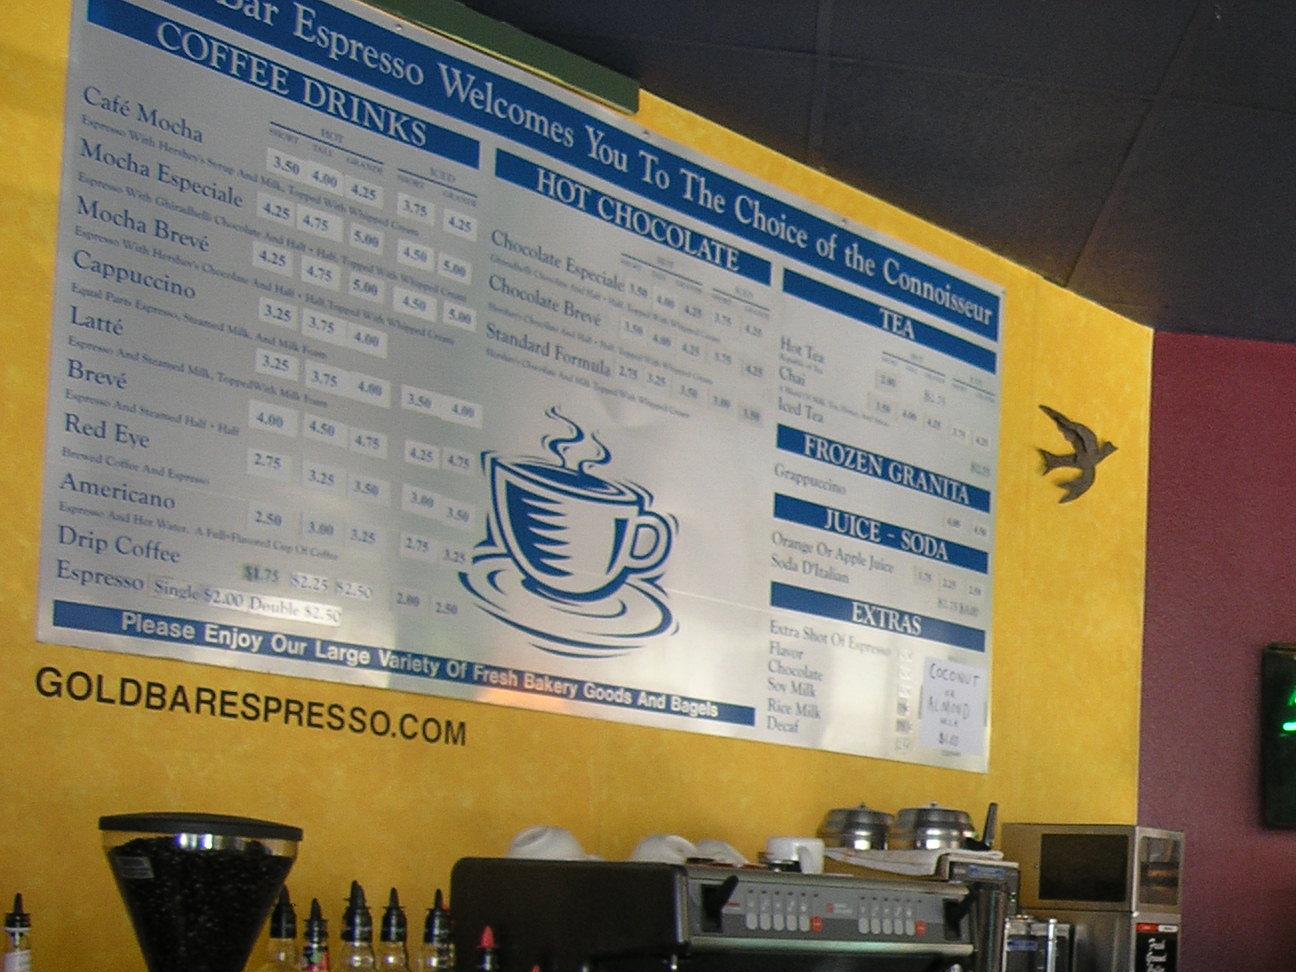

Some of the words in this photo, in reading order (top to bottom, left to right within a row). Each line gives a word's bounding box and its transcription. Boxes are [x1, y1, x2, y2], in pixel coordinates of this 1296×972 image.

[157, 21, 289, 95] COFFEE
[303, 77, 427, 147] DRINKS
[83, 85, 130, 117] Café
[137, 102, 203, 144] Mocha
[80, 137, 150, 178] Mocha
[157, 162, 243, 209] Especiale
[293, 2, 424, 86] Espresso
[436, 62, 574, 148] Welcomes
[584, 124, 629, 173] You
[638, 150, 670, 190] To
[680, 167, 726, 214] The
[734, 194, 808, 248] Choice
[817, 233, 838, 260] of
[845, 243, 876, 276] the
[883, 258, 992, 326] Connoisseur
[273, 156, 300, 175] 3.50
[312, 171, 338, 188] 4.00
[351, 183, 376, 201] 4.25
[402, 200, 427, 217] 3.75
[448, 216, 472, 233] 4.25
[77, 194, 147, 235] Mocha
[154, 218, 209, 252] Brevé
[263, 202, 290, 220] 4.25
[302, 214, 329, 231] 4.75
[354, 230, 379, 247] 5.00
[403, 245, 427, 262] 4.50
[443, 260, 466, 277] 5.00
[536, 168, 590, 210] HOT
[597, 195, 740, 271] CHOCOLATE
[73, 248, 196, 300] Cappuccino
[490, 228, 562, 268] Chocolate
[565, 257, 625, 293] Especiale
[258, 250, 286, 266] 4.25
[306, 265, 333, 282] 4.75
[352, 279, 378, 295] 5.00
[402, 296, 426, 312] 4.50
[448, 308, 472, 324] 5.00
[488, 273, 559, 313] Chocolate
[70, 305, 124, 336] Latté
[264, 304, 292, 321] 3.25
[308, 317, 335, 333] 3.75
[354, 332, 380, 347] 4.00
[879, 308, 916, 340] TEA
[486, 322, 550, 358] Standard
[555, 345, 611, 378] Formula
[67, 358, 127, 390] Brevé
[262, 354, 289, 371] 3.25
[311, 371, 338, 387] 3.75
[358, 381, 383, 396] 4.00
[64, 411, 107, 440] Red
[115, 422, 150, 448] Eye
[256, 411, 284, 428] 4.00
[309, 420, 336, 437] 4.50
[354, 435, 380, 450] 4.75
[254, 453, 281, 470] 2.75
[308, 469, 335, 486] 3.25
[354, 480, 379, 496] 3.50
[774, 462, 846, 495] Grappuccino
[803, 433, 884, 478] FROZEN
[888, 460, 971, 505] GRANITA
[59, 472, 176, 510] Americano
[58, 525, 108, 554] Drip
[115, 534, 180, 564] Coffee
[254, 510, 282, 527] 2.50
[307, 521, 334, 536] 3.00
[350, 528, 376, 544] 3.25
[825, 508, 882, 543] JUICE
[901, 530, 949, 561] SODA
[771, 530, 814, 555] Orange
[817, 541, 833, 557] Or
[835, 547, 866, 567] Apple
[869, 554, 894, 574] Juice
[771, 554, 798, 572] Soda
[56, 559, 144, 591] Espresso
[154, 578, 199, 601] Single
[203, 587, 243, 608] $2.00
[250, 596, 301, 617] Double
[770, 620, 800, 638] Extra
[803, 627, 827, 645] Shot
[831, 633, 845, 645] Of
[848, 637, 891, 657] Espresso
[852, 600, 922, 636] EXTRAS
[121, 611, 195, 640] Please
[204, 622, 262, 652] Enjoy
[271, 634, 308, 656] Our
[315, 639, 370, 667] Large
[378, 648, 440, 679] Variety
[446, 662, 468, 681] Of
[473, 664, 519, 688] Fresh
[523, 674, 578, 699] Bakery
[583, 682, 633, 705] Goods
[637, 690, 666, 710] And
[670, 695, 719, 721] Bagels
[768, 660, 824, 682] Chocolate
[769, 641, 803, 660] Flavor
[35, 666, 466, 746] GOLDBARESPRESSO.COM
[767, 678, 787, 695] Soy
[790, 682, 816, 698] Milk
[767, 698, 792, 715] Rice
[795, 703, 821, 719] Milk
[767, 716, 799, 733] Decaf
